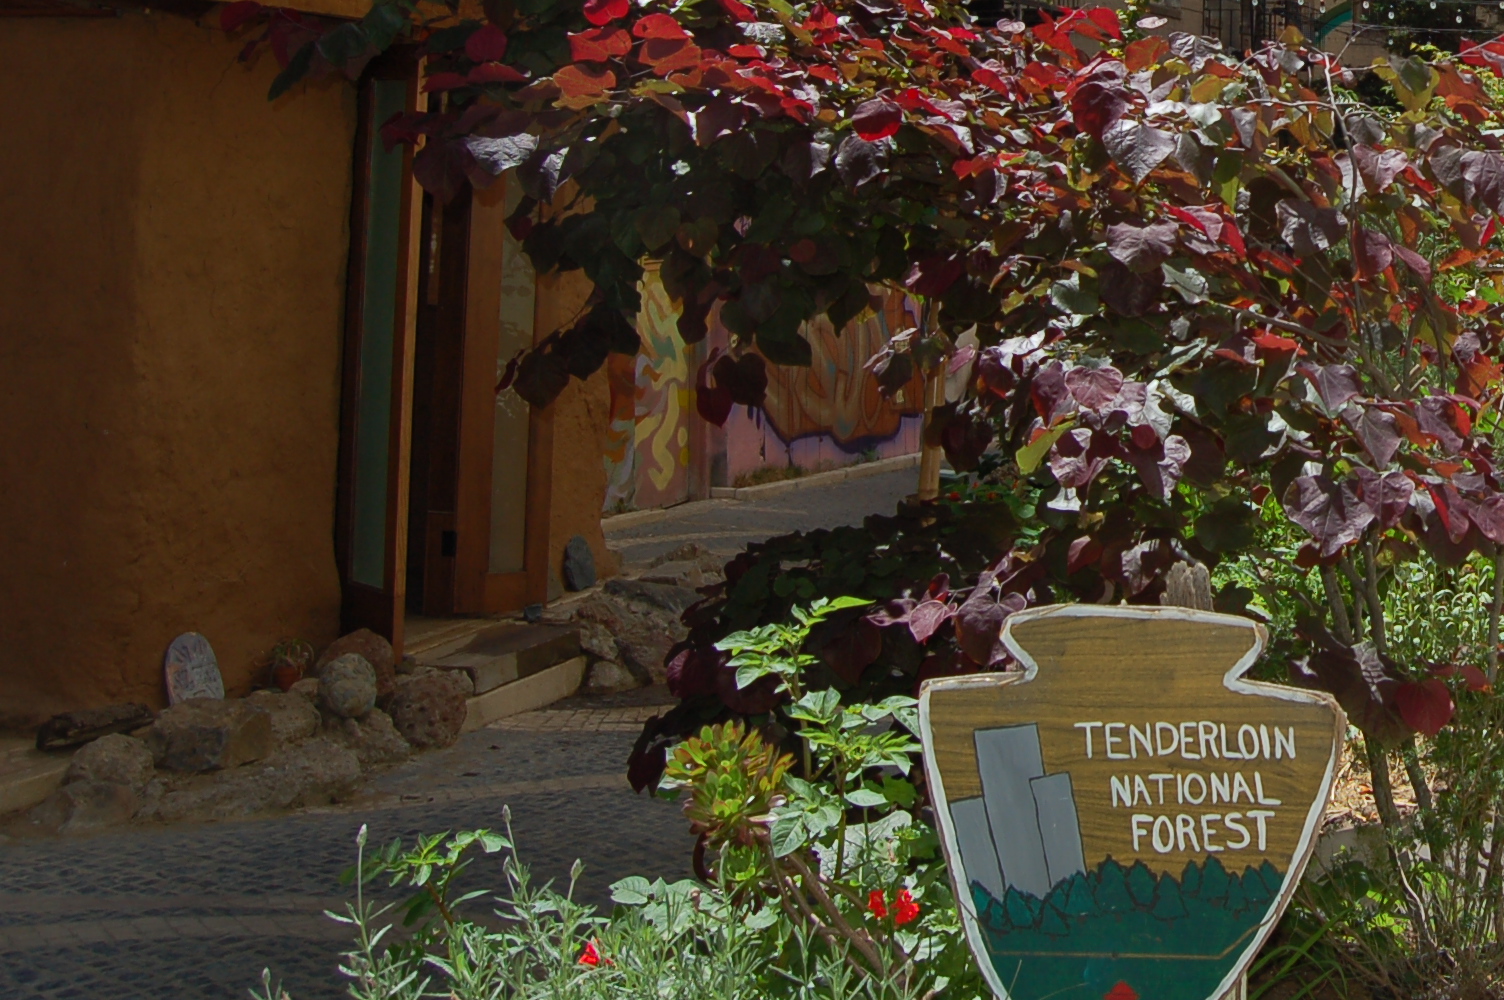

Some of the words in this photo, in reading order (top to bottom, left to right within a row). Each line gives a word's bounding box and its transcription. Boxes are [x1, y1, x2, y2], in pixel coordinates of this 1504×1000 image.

[1074, 721, 1297, 760] TENDERLOIN
[1110, 771, 1282, 808] NATIONAL
[1131, 810, 1276, 854] FOREST
